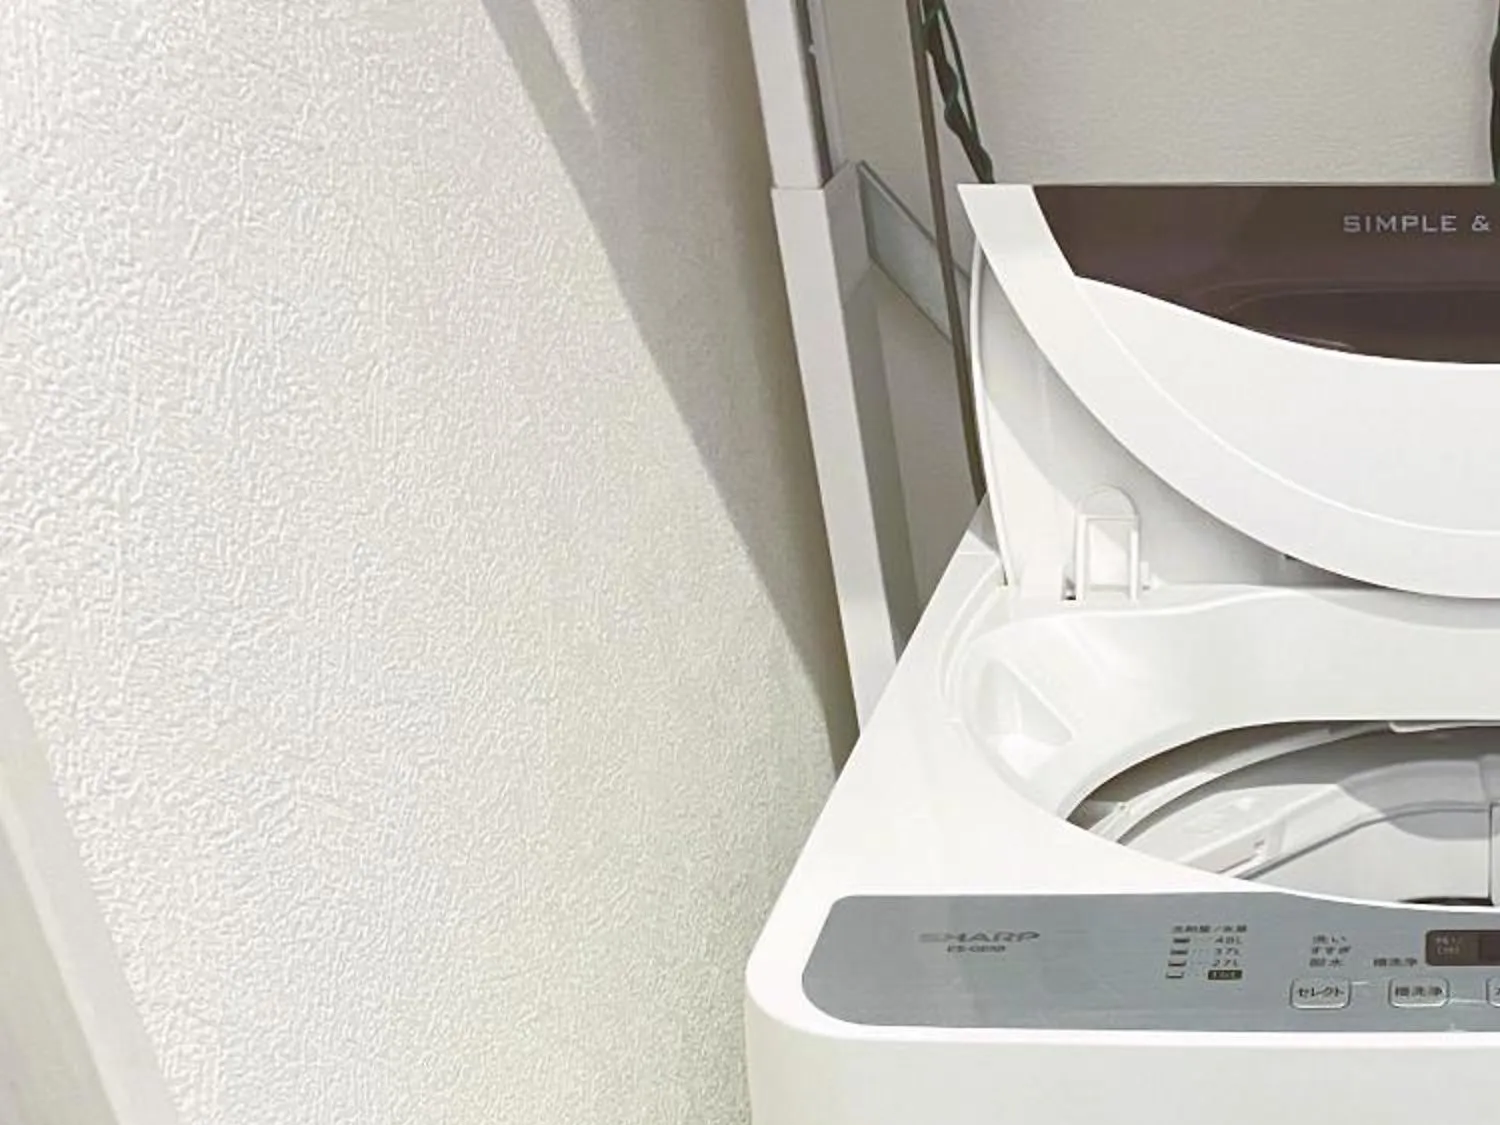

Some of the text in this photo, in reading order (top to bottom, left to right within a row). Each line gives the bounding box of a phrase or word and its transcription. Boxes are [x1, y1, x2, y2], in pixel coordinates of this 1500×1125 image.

[1343, 215, 1457, 232] SIMPLE
[1471, 215, 1490, 231] &
[918, 930, 1041, 943] SHARP
[1298, 986, 1345, 998] セレクト
